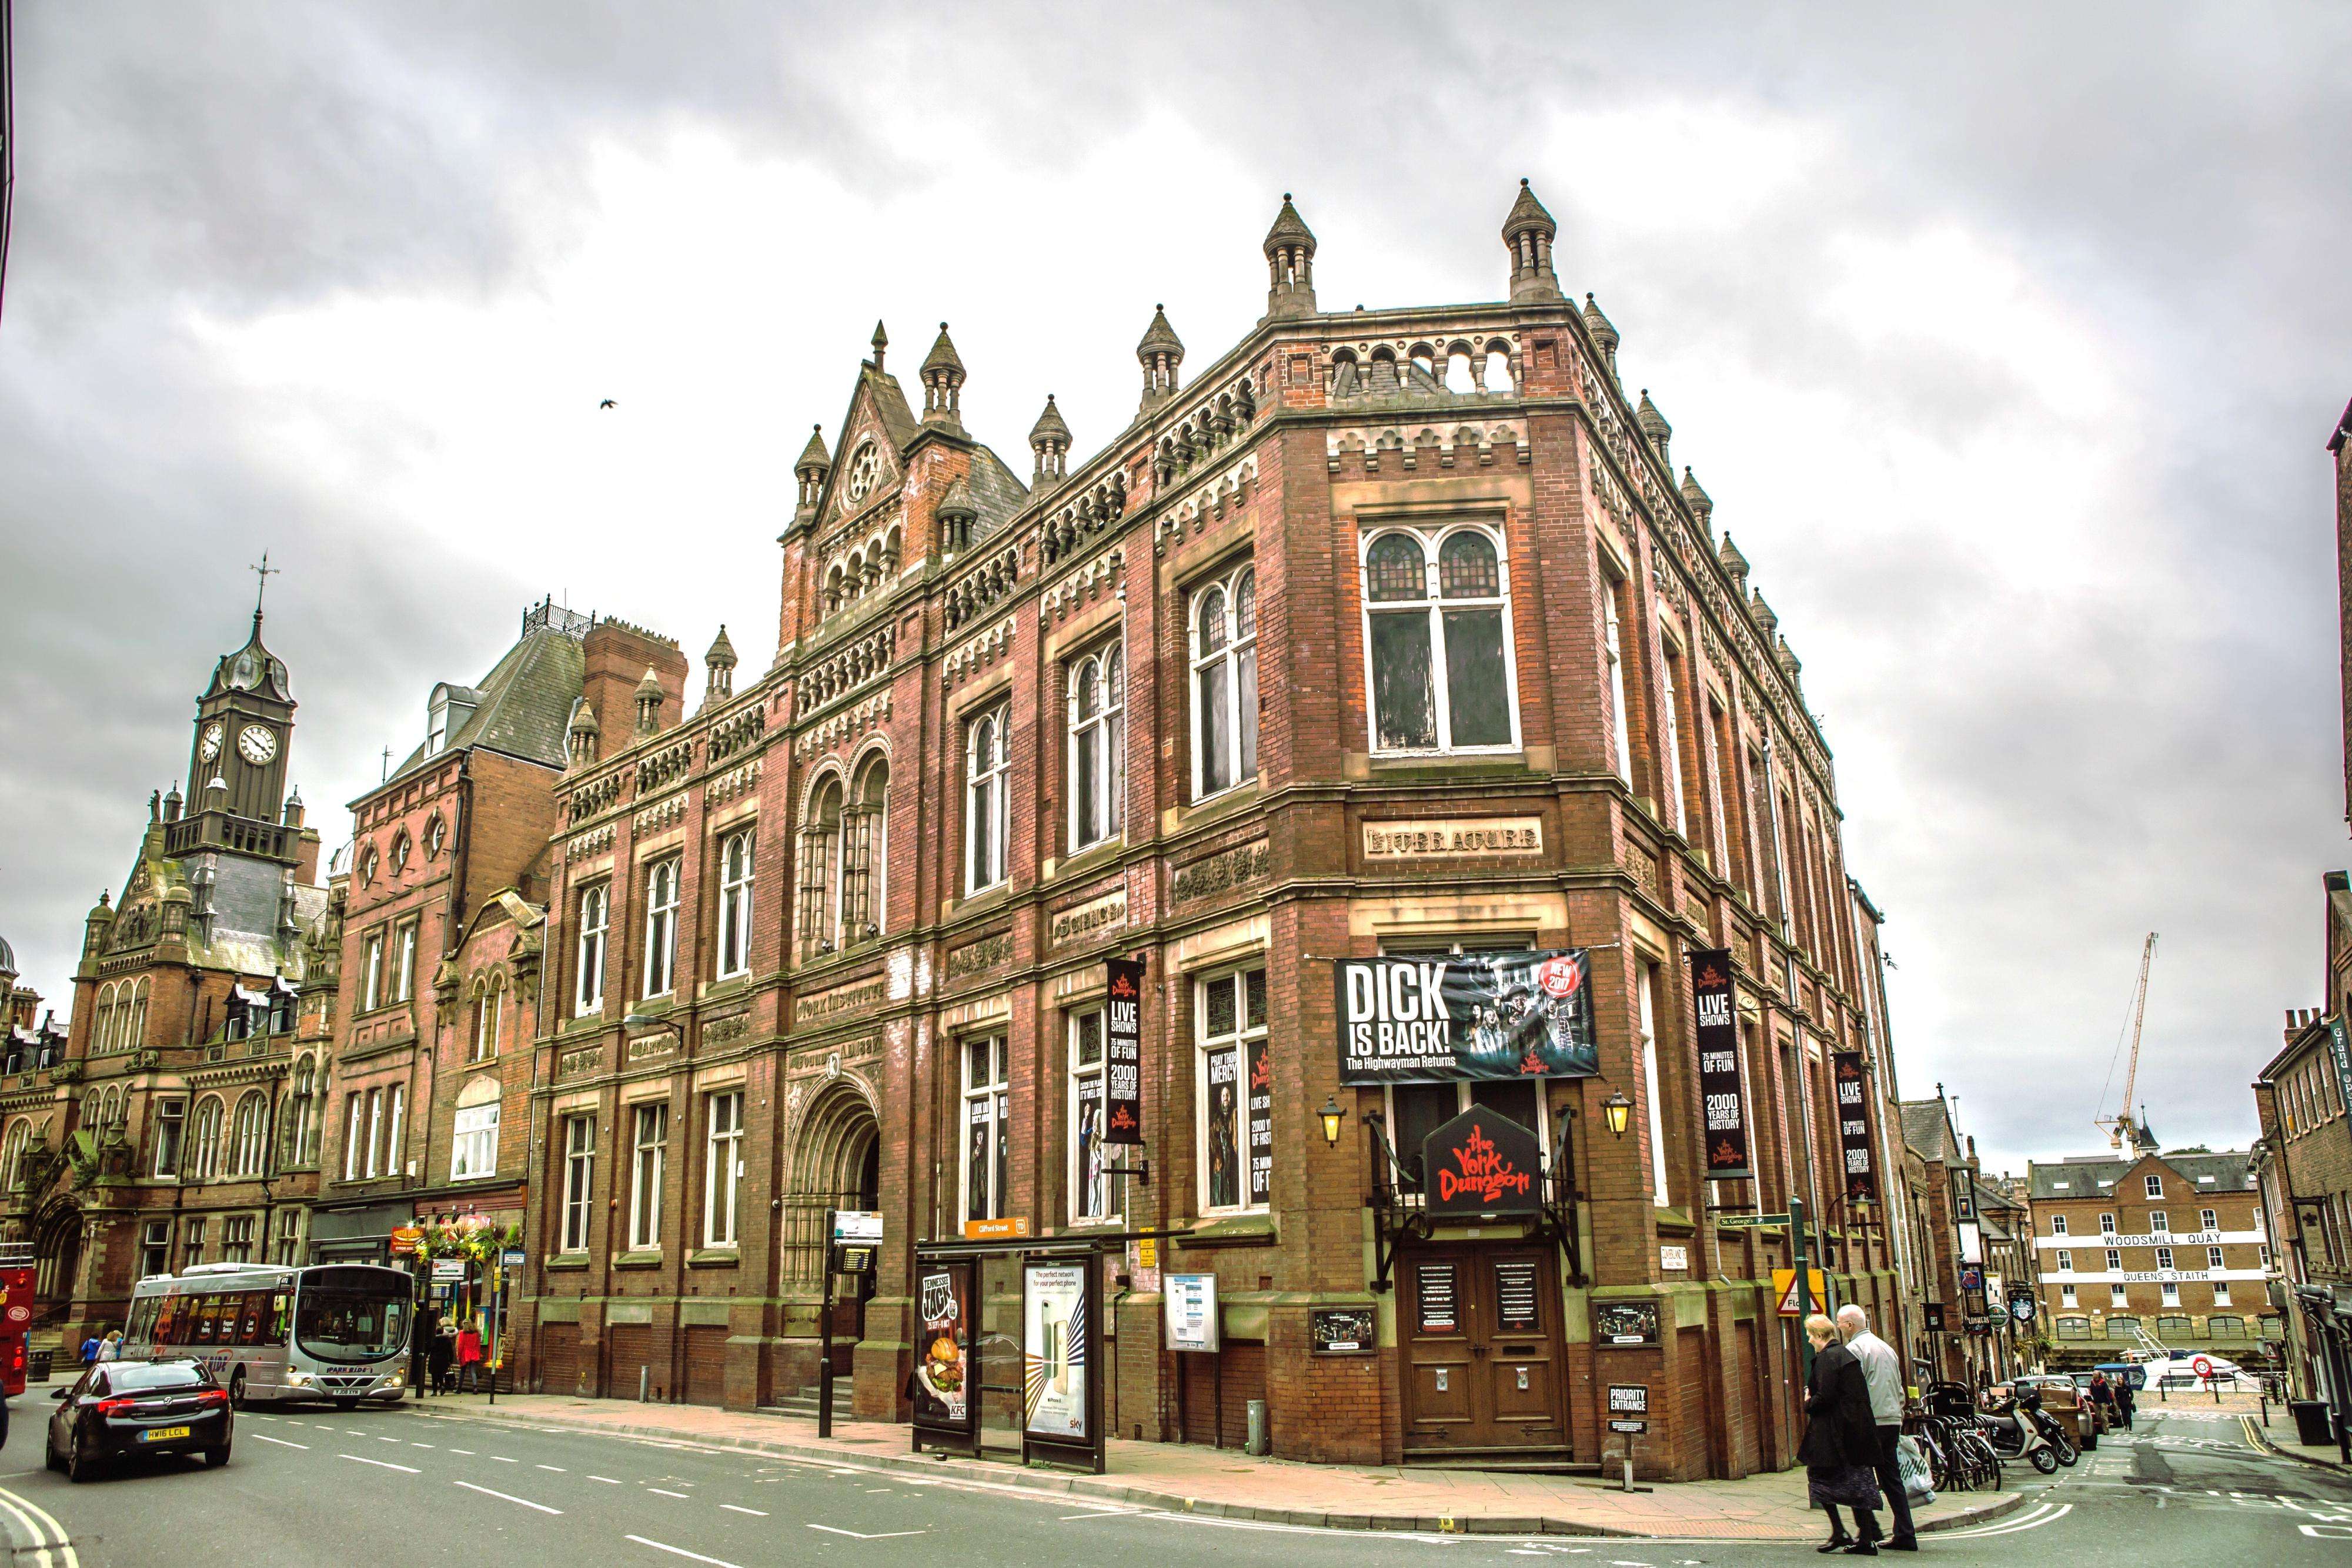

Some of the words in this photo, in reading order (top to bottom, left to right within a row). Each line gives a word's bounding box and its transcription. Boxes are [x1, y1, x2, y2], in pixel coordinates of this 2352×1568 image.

[1551, 962, 1572, 975] NEW
[1548, 975, 1570, 991] 2017
[1346, 962, 1450, 1022] DICK
[1111, 1001, 1136, 1022] LIVE
[1698, 994, 1729, 1016] LIVE
[1111, 1020, 1136, 1034] SHOWS
[1700, 1013, 1730, 1027] SHOWS
[1111, 1038, 1117, 1046] 75
[1117, 1038, 1137, 1047] MINUTES
[1349, 1023, 1372, 1057] IS
[1379, 1021, 1450, 1055] BACK!
[1111, 1046, 1121, 1058] OF
[1122, 1047, 1137, 1059] FUN
[1710, 1051, 1733, 1059] MINUTES
[2334, 1028, 2348, 1068] Grand
[1211, 1053, 1223, 1067] PRAY
[1347, 1058, 1362, 1071] The
[1364, 1057, 1419, 1071] Highwayman
[1422, 1056, 1456, 1068] Returns
[1704, 1059, 1716, 1072] OF
[1717, 1058, 1734, 1072] FUN
[1111, 1064, 1137, 1081] 2000
[1211, 1062, 1237, 1084] MERCY
[1111, 1079, 1129, 1090] YEARS
[1130, 1081, 1137, 1091] OF
[1839, 1082, 1861, 1096] LIVE
[1087, 1088, 1096, 1099] WELL
[1111, 1089, 1137, 1100] HISTORY
[1840, 1095, 1862, 1104] SHOWS
[972, 1102, 983, 1115] LOOK
[1251, 1096, 1262, 1111] LIVE
[1706, 1094, 1738, 1111] 2000
[1708, 1109, 1729, 1120] YEARS
[1730, 1109, 1739, 1118] OF
[1252, 1120, 1265, 1134] 2000
[1709, 1118, 1739, 1131] HISTORY
[1843, 1126, 1852, 1135] OF
[1853, 1126, 1865, 1135] FUN
[1252, 1135, 1259, 1147] OF
[1466, 1124, 1494, 1153] the
[1452, 1148, 1512, 1176] York
[1846, 1149, 1868, 1161] 2000
[1252, 1158, 1259, 1170] 75
[1253, 1171, 1264, 1192] OF
[1438, 1169, 1530, 1203] Dungeon
[978, 1225, 994, 1233] Clifford
[2104, 1235, 2179, 1246] WOODSMILL
[2188, 1233, 2221, 1243] QUAY
[924, 1276, 948, 1290] TENNESSEE
[2124, 1272, 2164, 1281] QUEENS
[2171, 1272, 2209, 1280] STAITH
[923, 1285, 951, 1319] JACK
[928, 1321, 932, 1329] 25
[1611, 1389, 1645, 1401] PRIORITY
[950, 1405, 965, 1415] KFC
[1611, 1400, 1646, 1411] ENTRANCE
[1070, 1417, 1082, 1432] sky
[149, 1430, 167, 1439] HW16
